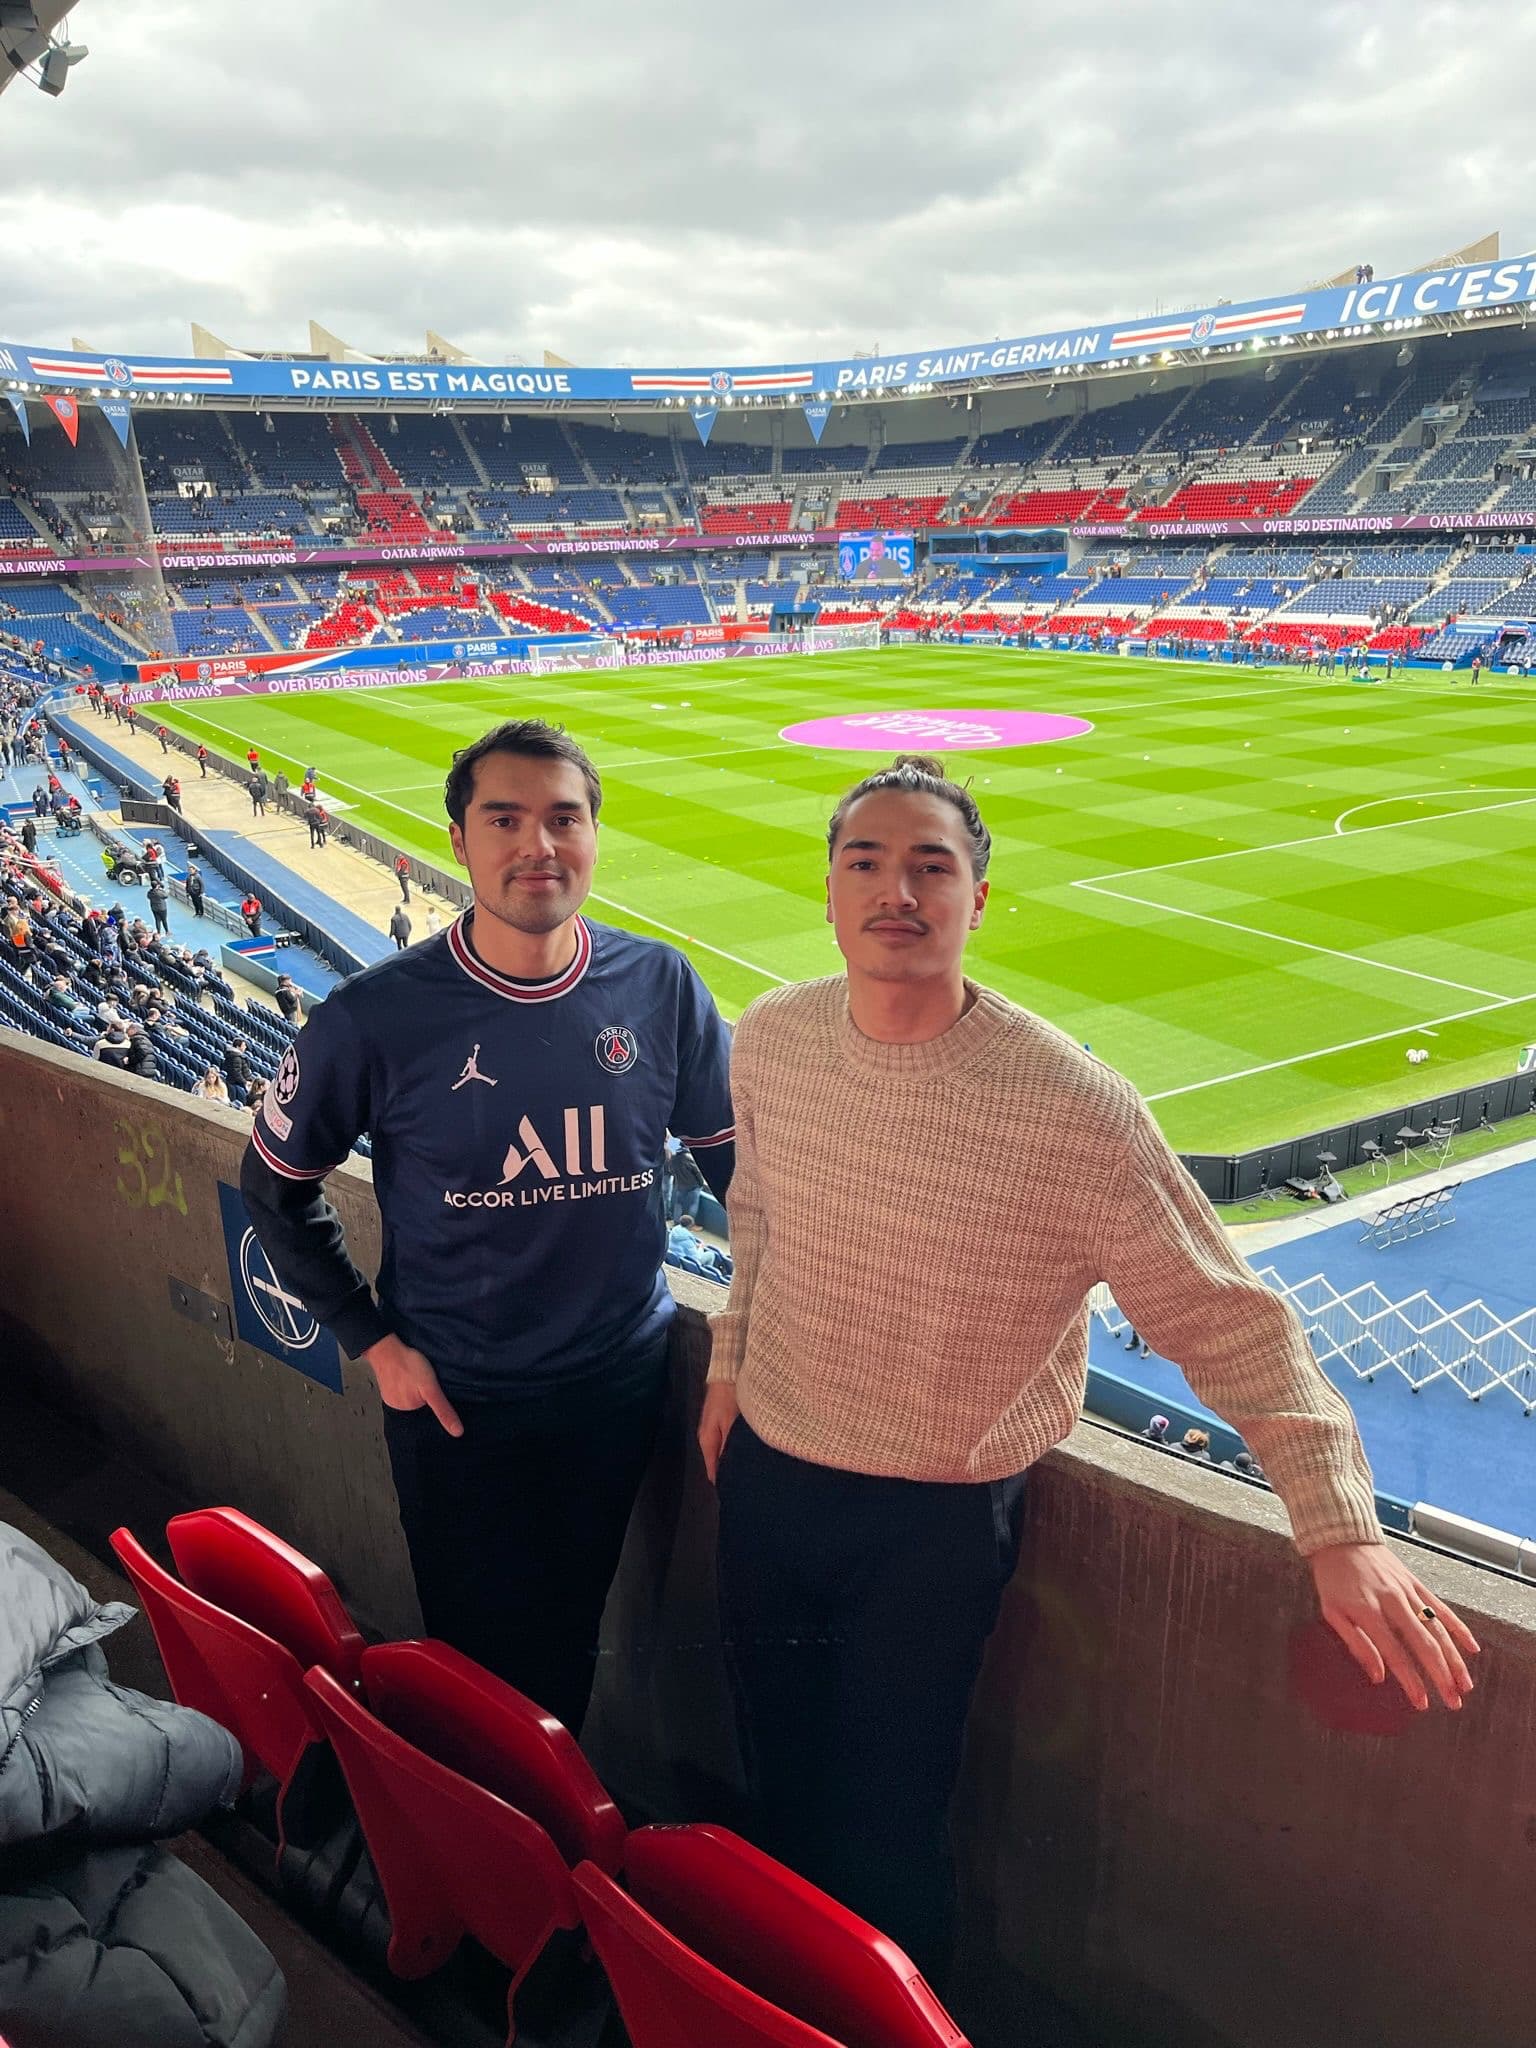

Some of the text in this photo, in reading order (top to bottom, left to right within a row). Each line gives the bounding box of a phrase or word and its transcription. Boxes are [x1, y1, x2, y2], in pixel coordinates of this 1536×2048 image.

[1340, 283, 1402, 322] ICI
[837, 333, 1100, 388] PARIS SAINT-GERMAIN
[290, 369, 572, 393] PARIS EST MAGIQUE
[173, 467, 205, 477] QATAR
[521, 464, 548, 473] QATAR
[1263, 517, 1393, 532] OVER 150 DESTINATIONS
[1430, 513, 1535, 529] QATAR AIRWAYS
[1073, 526, 1096, 535] QATAR
[1150, 522, 1228, 535] QATAR AIRWAYS
[547, 540, 659, 553] OVER 150 DESTINATIONS
[736, 534, 815, 546] QATAR AIRWAYS
[382, 547, 465, 560] QATAR AIRWAYS
[860, 547, 911, 570] PIS
[17, 560, 66, 572] AIRWAYS
[163, 553, 296, 568] OVER 150 DESTINATIONS
[695, 629, 724, 637] PARIS
[467, 642, 498, 653] PARIS
[754, 643, 788, 656] QATAR
[629, 653, 647, 666] 150
[648, 647, 726, 664] DESTINATIONS
[213, 660, 247, 671] PARIS
[268, 669, 428, 692] OVER 150 DESTINATIONS
[161, 685, 222, 700] AIRWAYS
[600, 1029, 628, 1040] PARIS
[444, 1168, 654, 1208] ACCOR LIVE LIMITLESS
